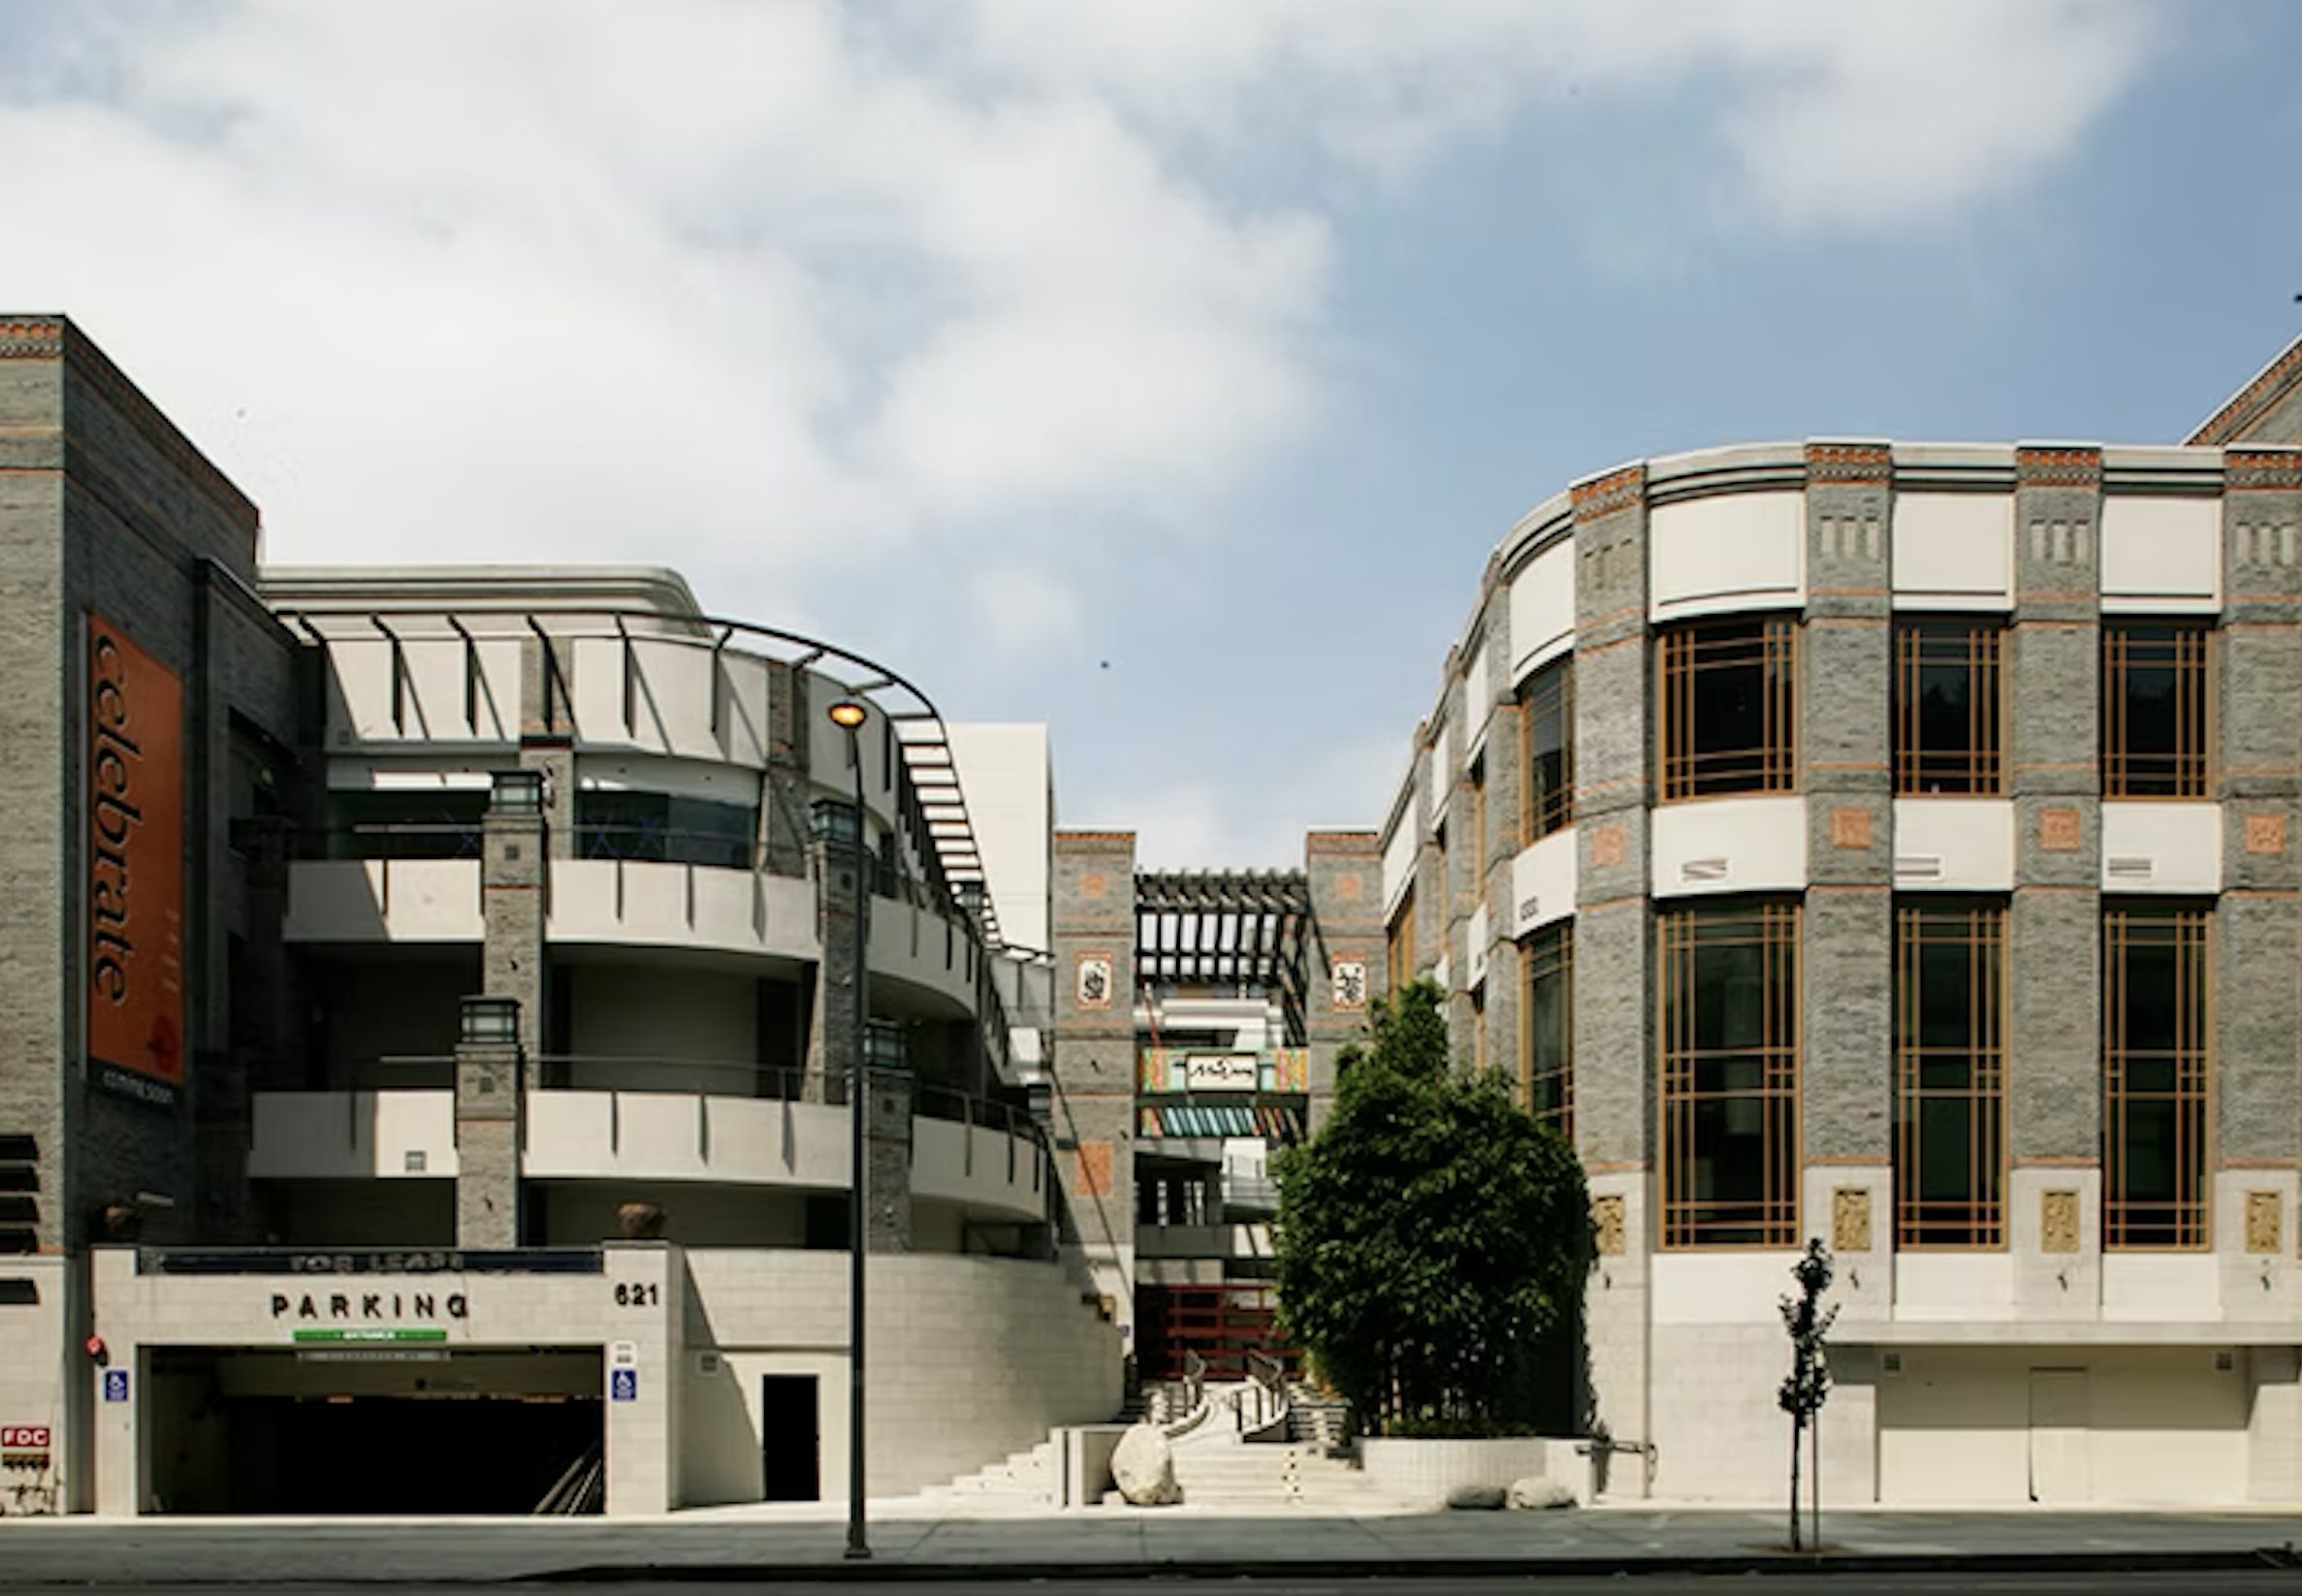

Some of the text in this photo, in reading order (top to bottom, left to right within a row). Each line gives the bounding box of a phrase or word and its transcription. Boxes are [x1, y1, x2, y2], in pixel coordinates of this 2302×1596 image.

[94, 634, 144, 1005] celebrate
[614, 1283, 657, 1305] 621
[272, 1293, 469, 1320] PARKING
[3, 1428, 48, 1446] FDC
